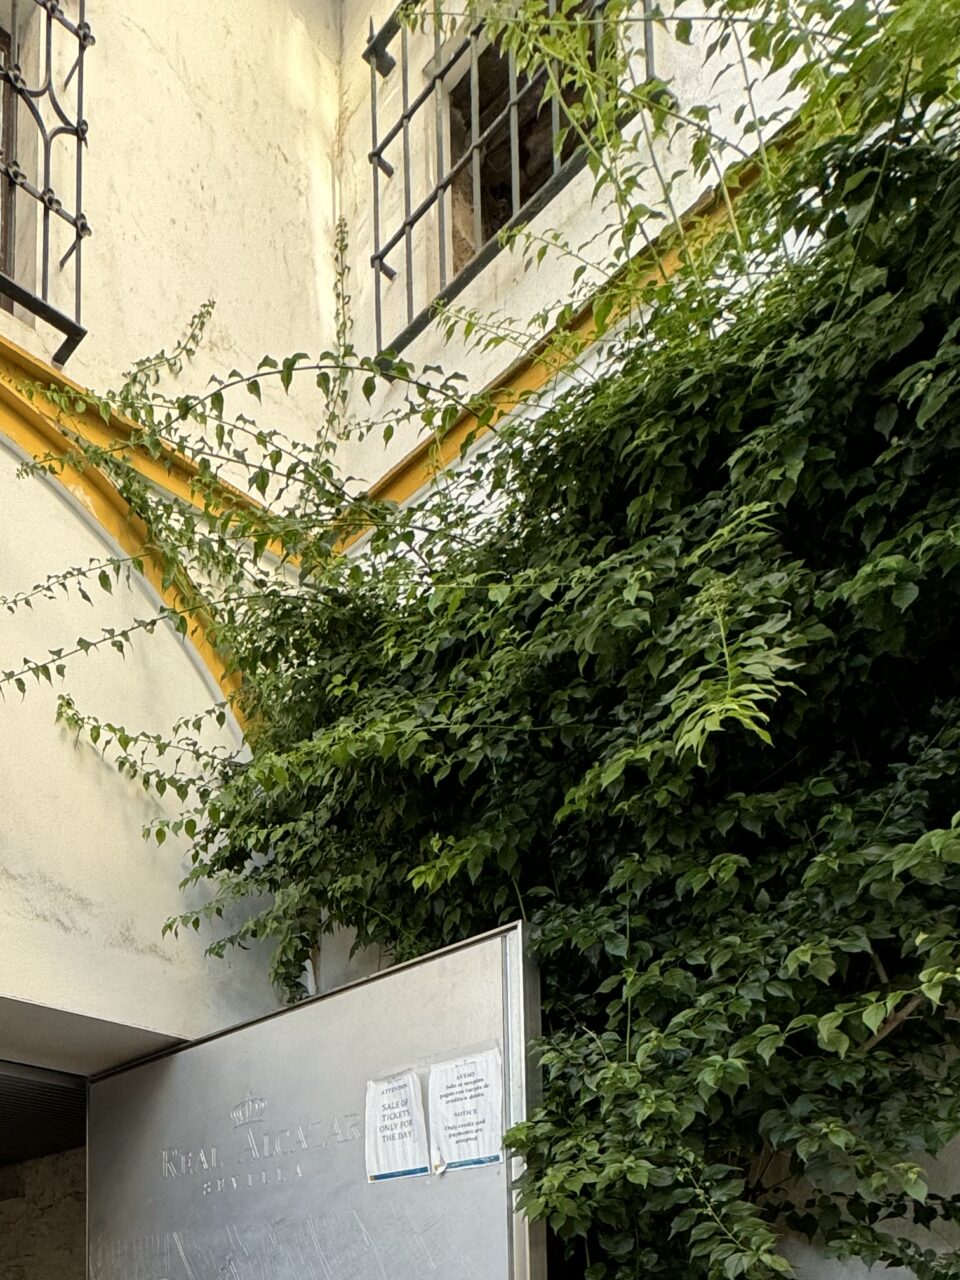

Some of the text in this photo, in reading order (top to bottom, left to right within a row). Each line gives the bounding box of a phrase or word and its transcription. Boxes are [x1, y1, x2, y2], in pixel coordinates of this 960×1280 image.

[382, 1098, 409, 1113] SALE OF
[382, 1109, 412, 1122] TICKETS
[379, 1119, 413, 1133] ONLY FOR
[382, 1130, 413, 1143] THE DAY
[161, 1147, 223, 1178] REAL
[203, 1163, 304, 1196] SEVILLA
